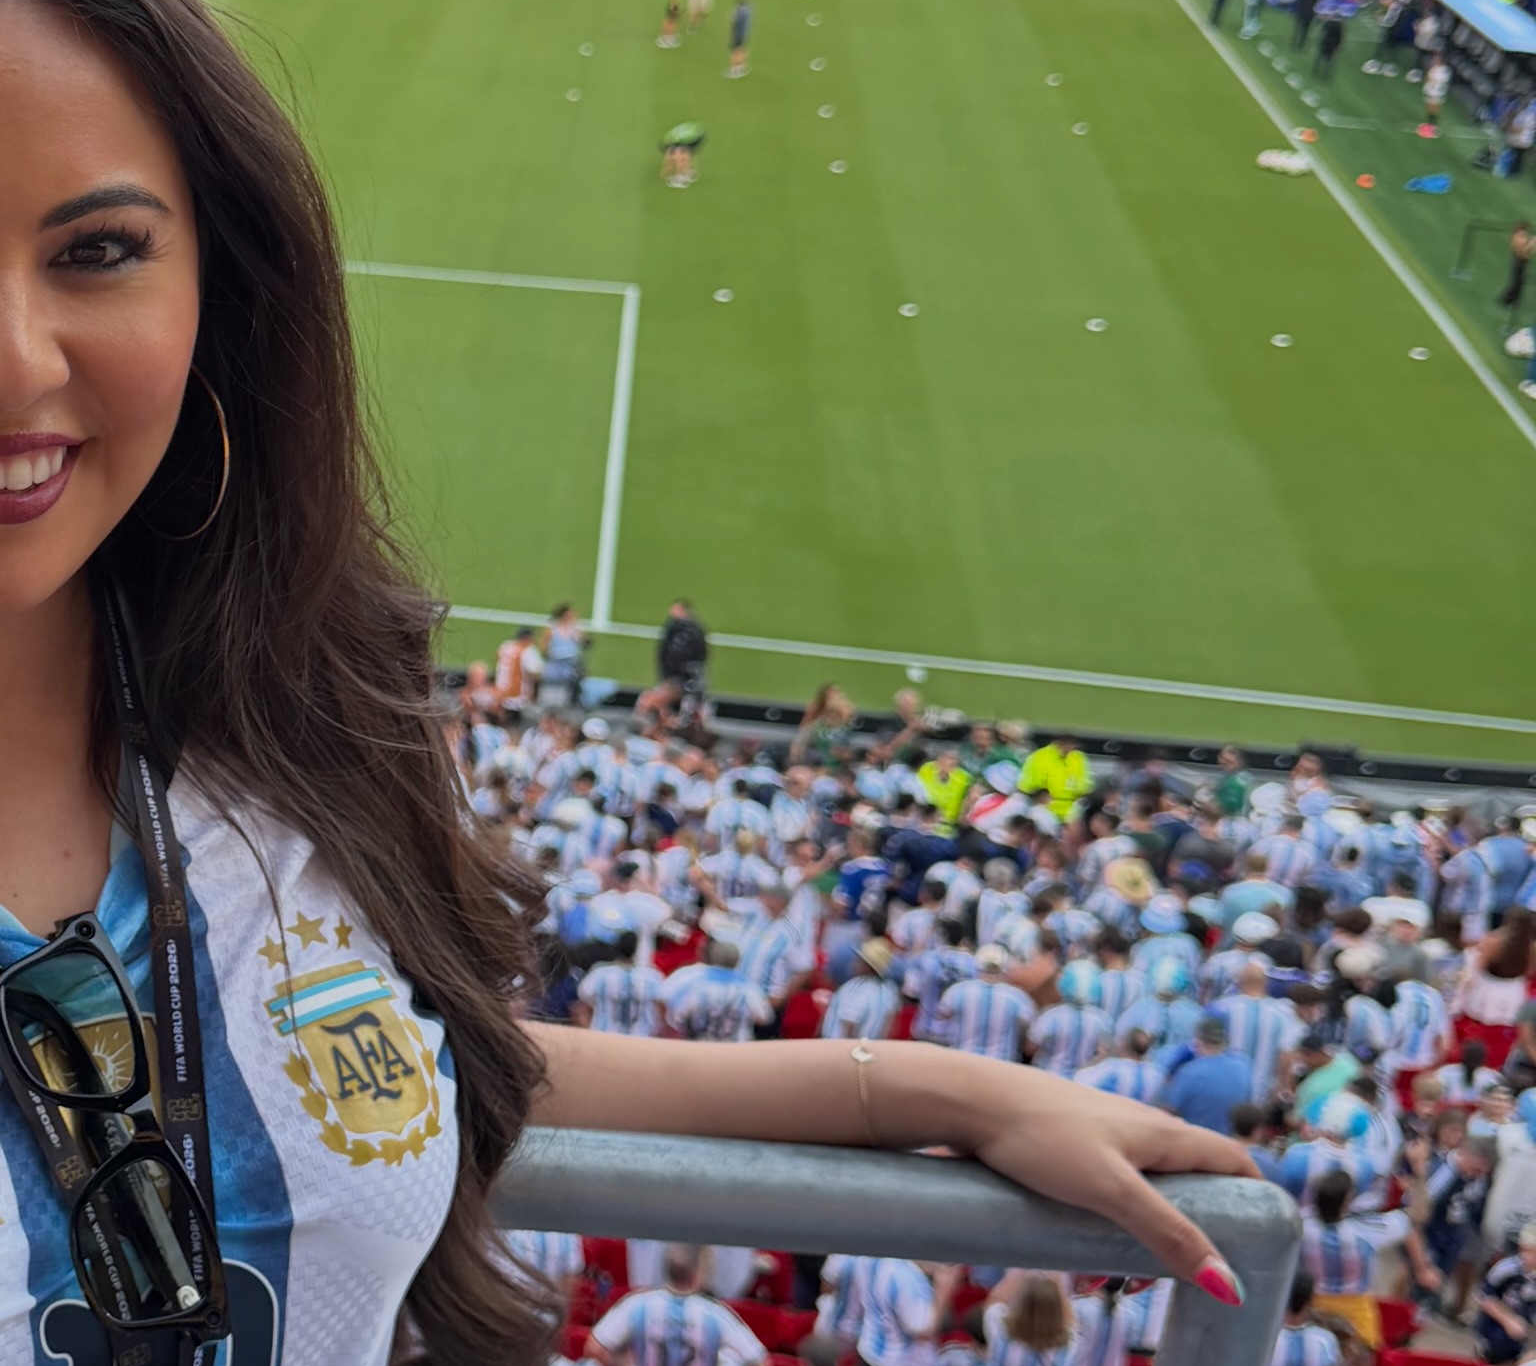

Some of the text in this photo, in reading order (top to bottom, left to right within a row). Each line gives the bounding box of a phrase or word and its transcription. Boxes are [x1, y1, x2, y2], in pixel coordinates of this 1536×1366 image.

[146, 796, 159, 820] CUP
[152, 820, 166, 861] WORLD
[170, 985, 182, 1010] CUP
[172, 1010, 185, 1055] WORLD
[175, 1055, 188, 1083] FIFA
[320, 1011, 415, 1101] AFA
[84, 1201, 132, 1321] IFA WORLD CUP 202
